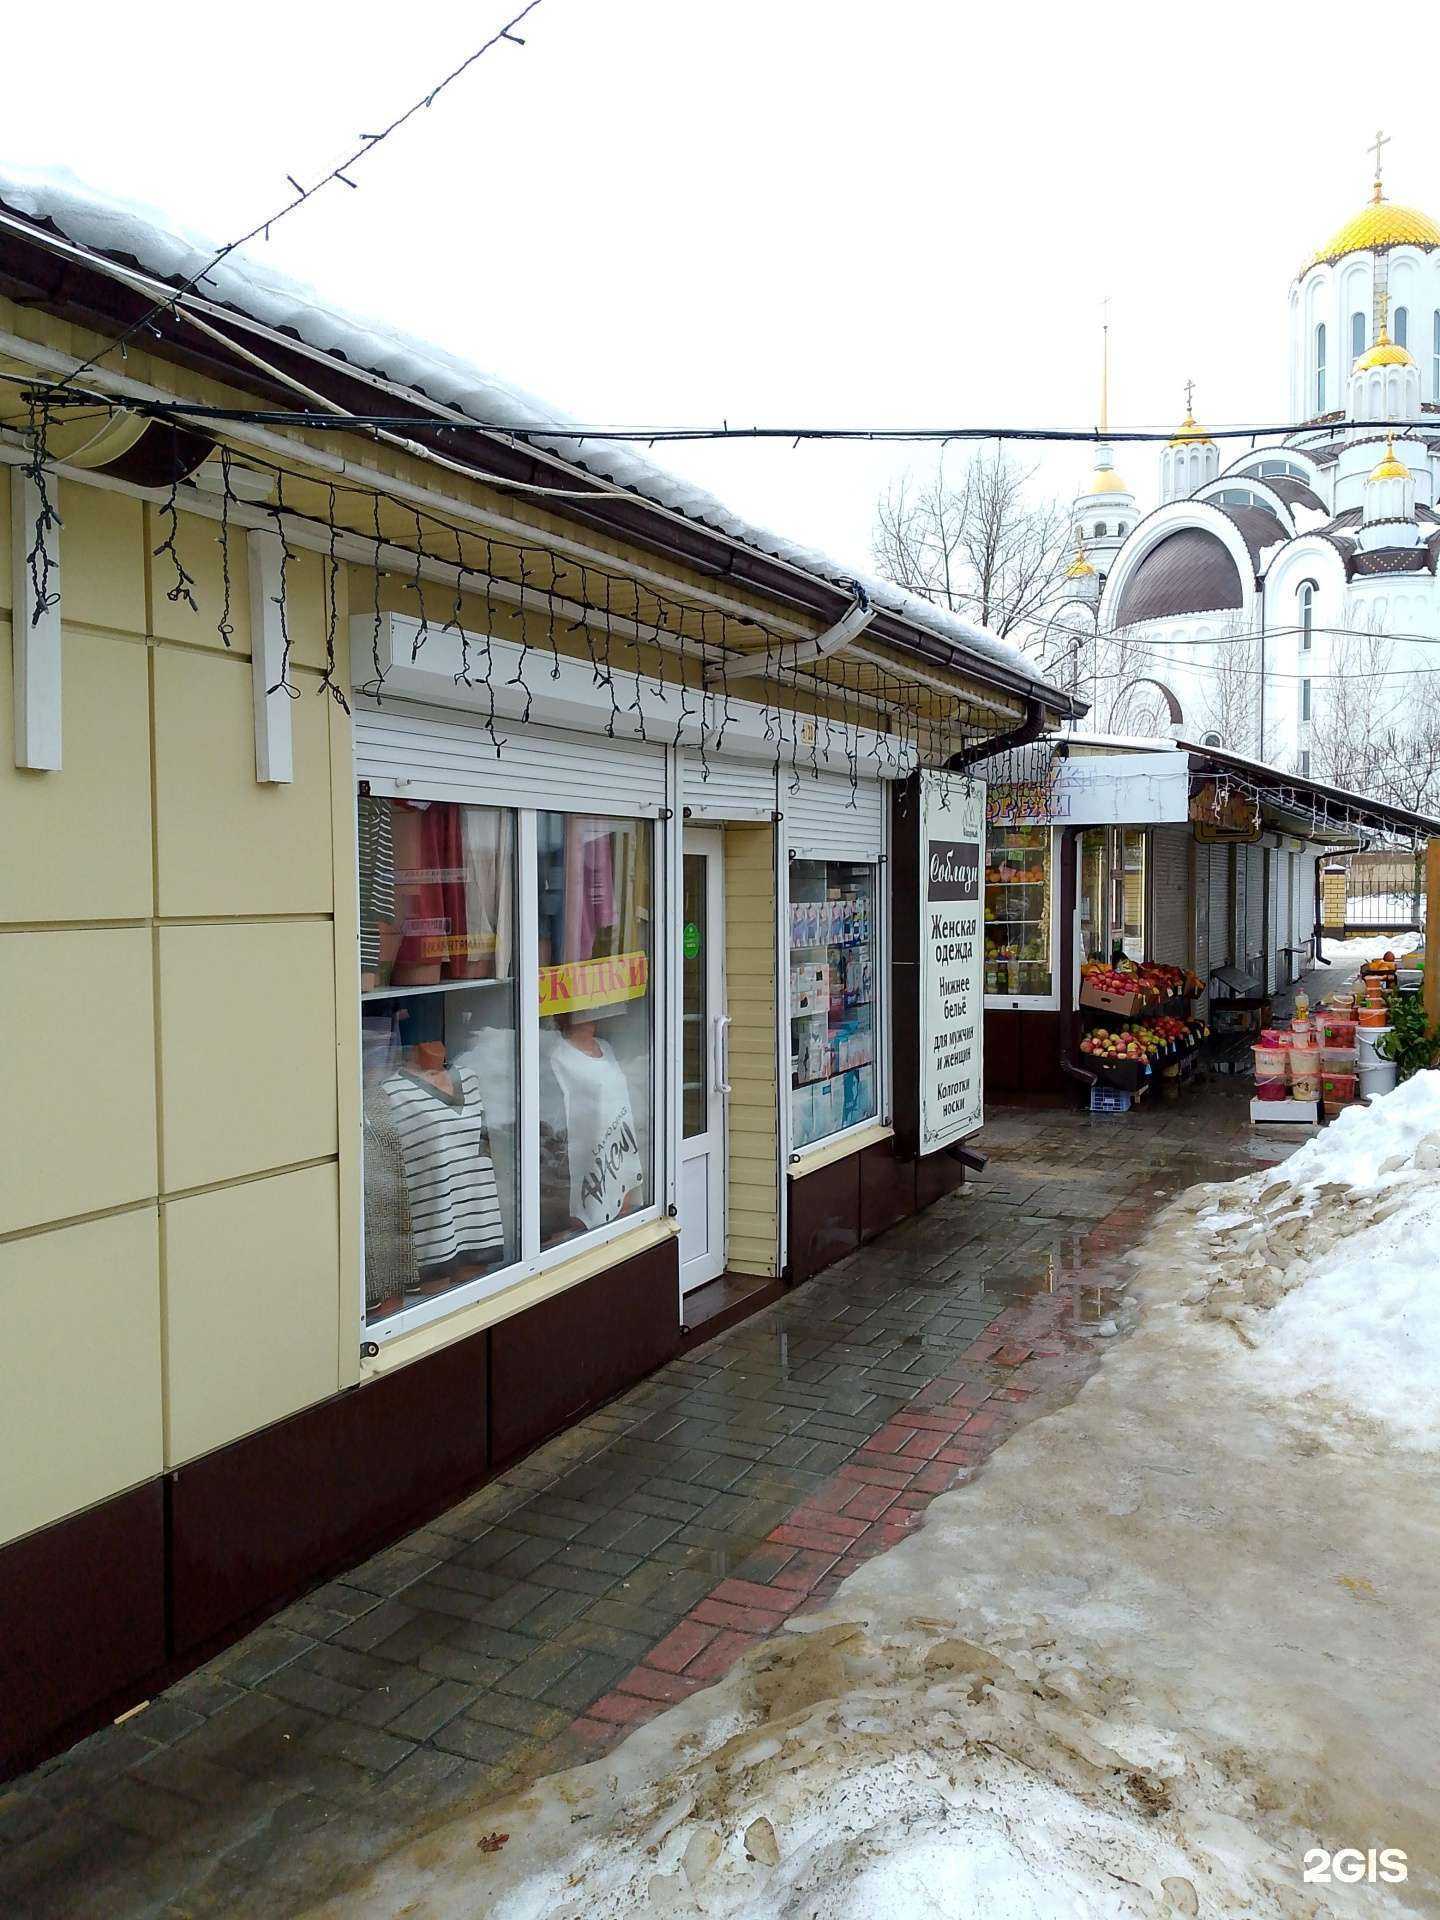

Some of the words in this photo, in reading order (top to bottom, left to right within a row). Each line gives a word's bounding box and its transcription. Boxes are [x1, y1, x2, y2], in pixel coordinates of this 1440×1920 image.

[930, 849, 978, 893] Соблазн
[931, 914, 976, 939] Женская
[935, 941, 973, 967] одежда
[939, 976, 970, 997] Нижнее
[943, 996, 967, 1019] бельё
[933, 1033, 948, 1054] для
[949, 1026, 974, 1050] мужчин
[936, 1056, 943, 1071] и
[943, 1047, 971, 1069] женщин
[937, 1078, 970, 1101] Колготки
[942, 1097, 965, 1118] носки
